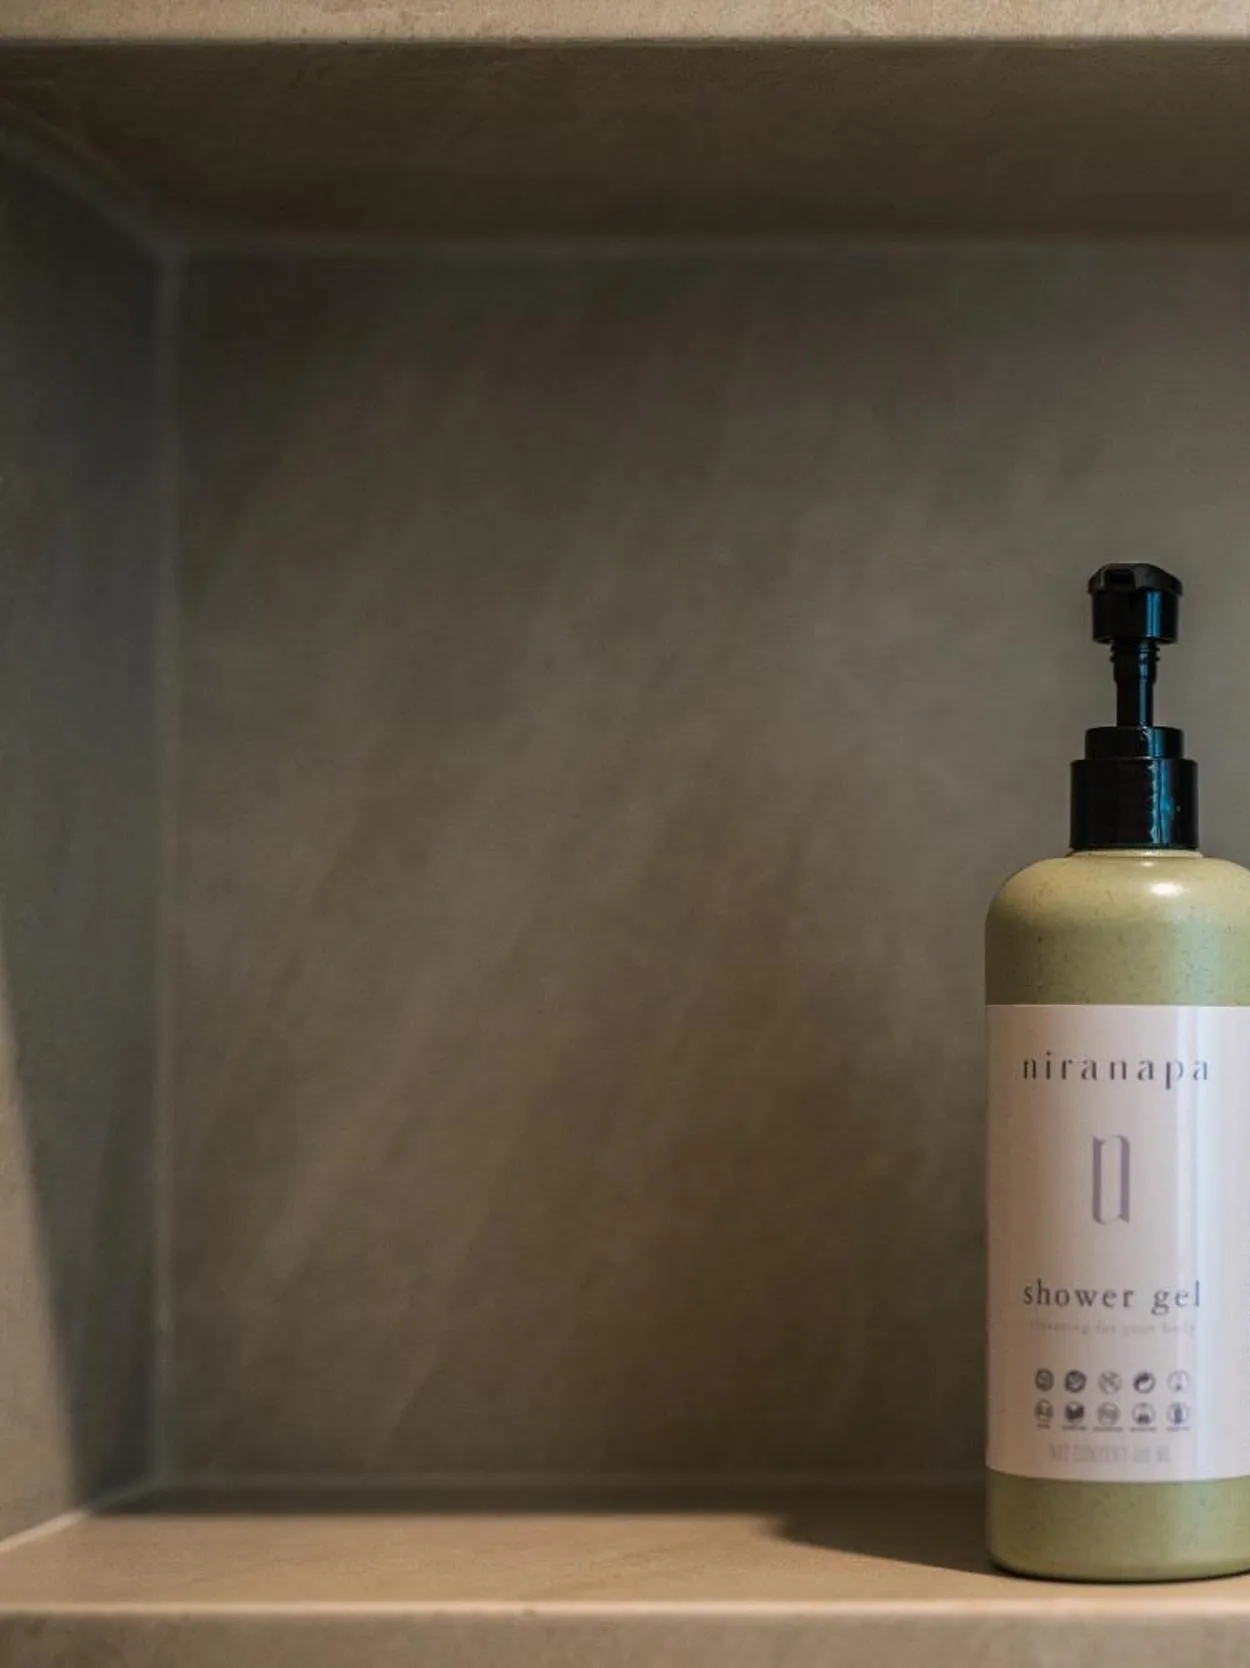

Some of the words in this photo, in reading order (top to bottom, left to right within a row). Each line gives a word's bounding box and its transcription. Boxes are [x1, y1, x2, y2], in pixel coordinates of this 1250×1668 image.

[1022, 1050, 1208, 1089] niranapa
[1022, 1278, 1134, 1309] shower
[1150, 1279, 1200, 1316] gel
